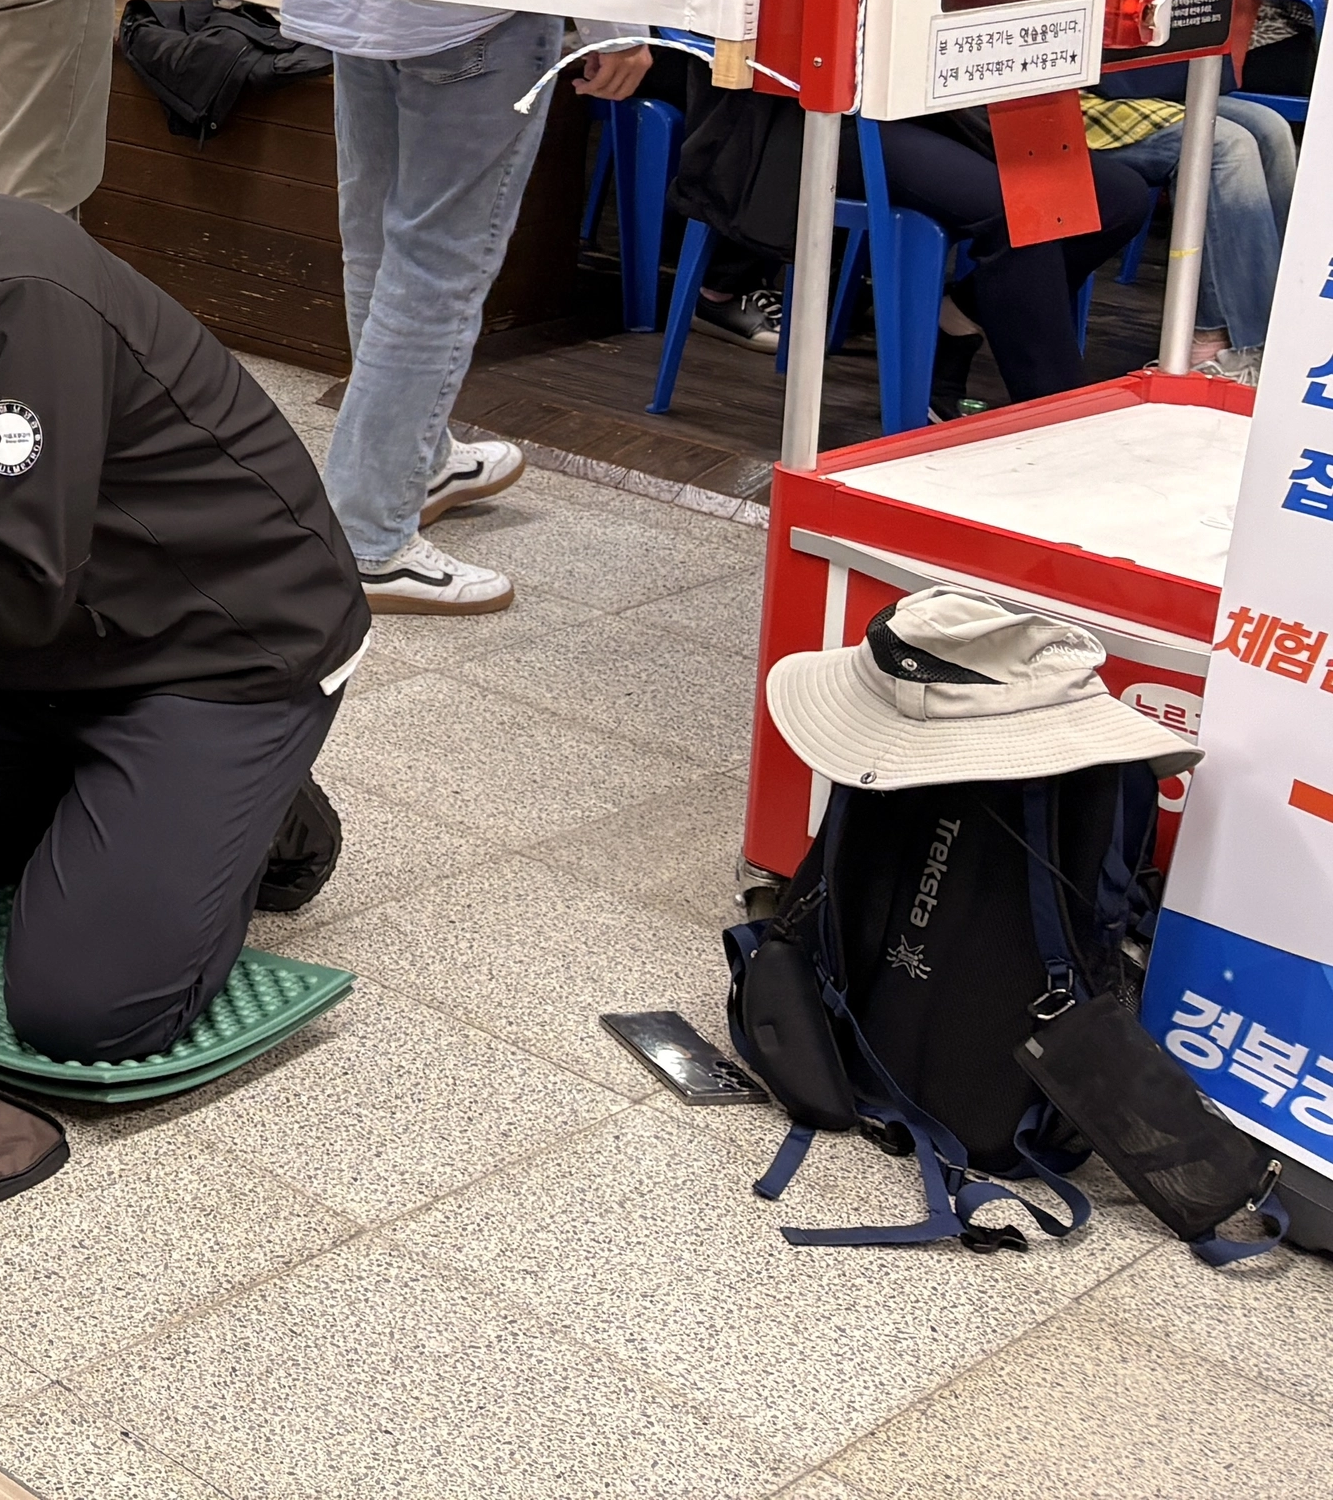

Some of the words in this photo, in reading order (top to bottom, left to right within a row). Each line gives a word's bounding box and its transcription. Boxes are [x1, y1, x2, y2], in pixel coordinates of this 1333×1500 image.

[938, 39, 948, 55] 본
[954, 29, 1014, 53] 심장충격기는
[1019, 19, 1081, 46] 연습용입니다.
[938, 67, 959, 87] 실제
[965, 58, 1015, 81] 심정지환자
[1212, 606, 1333, 694] 체험
[1136, 693, 1200, 736] 누르
[909, 818, 961, 928] Treksta
